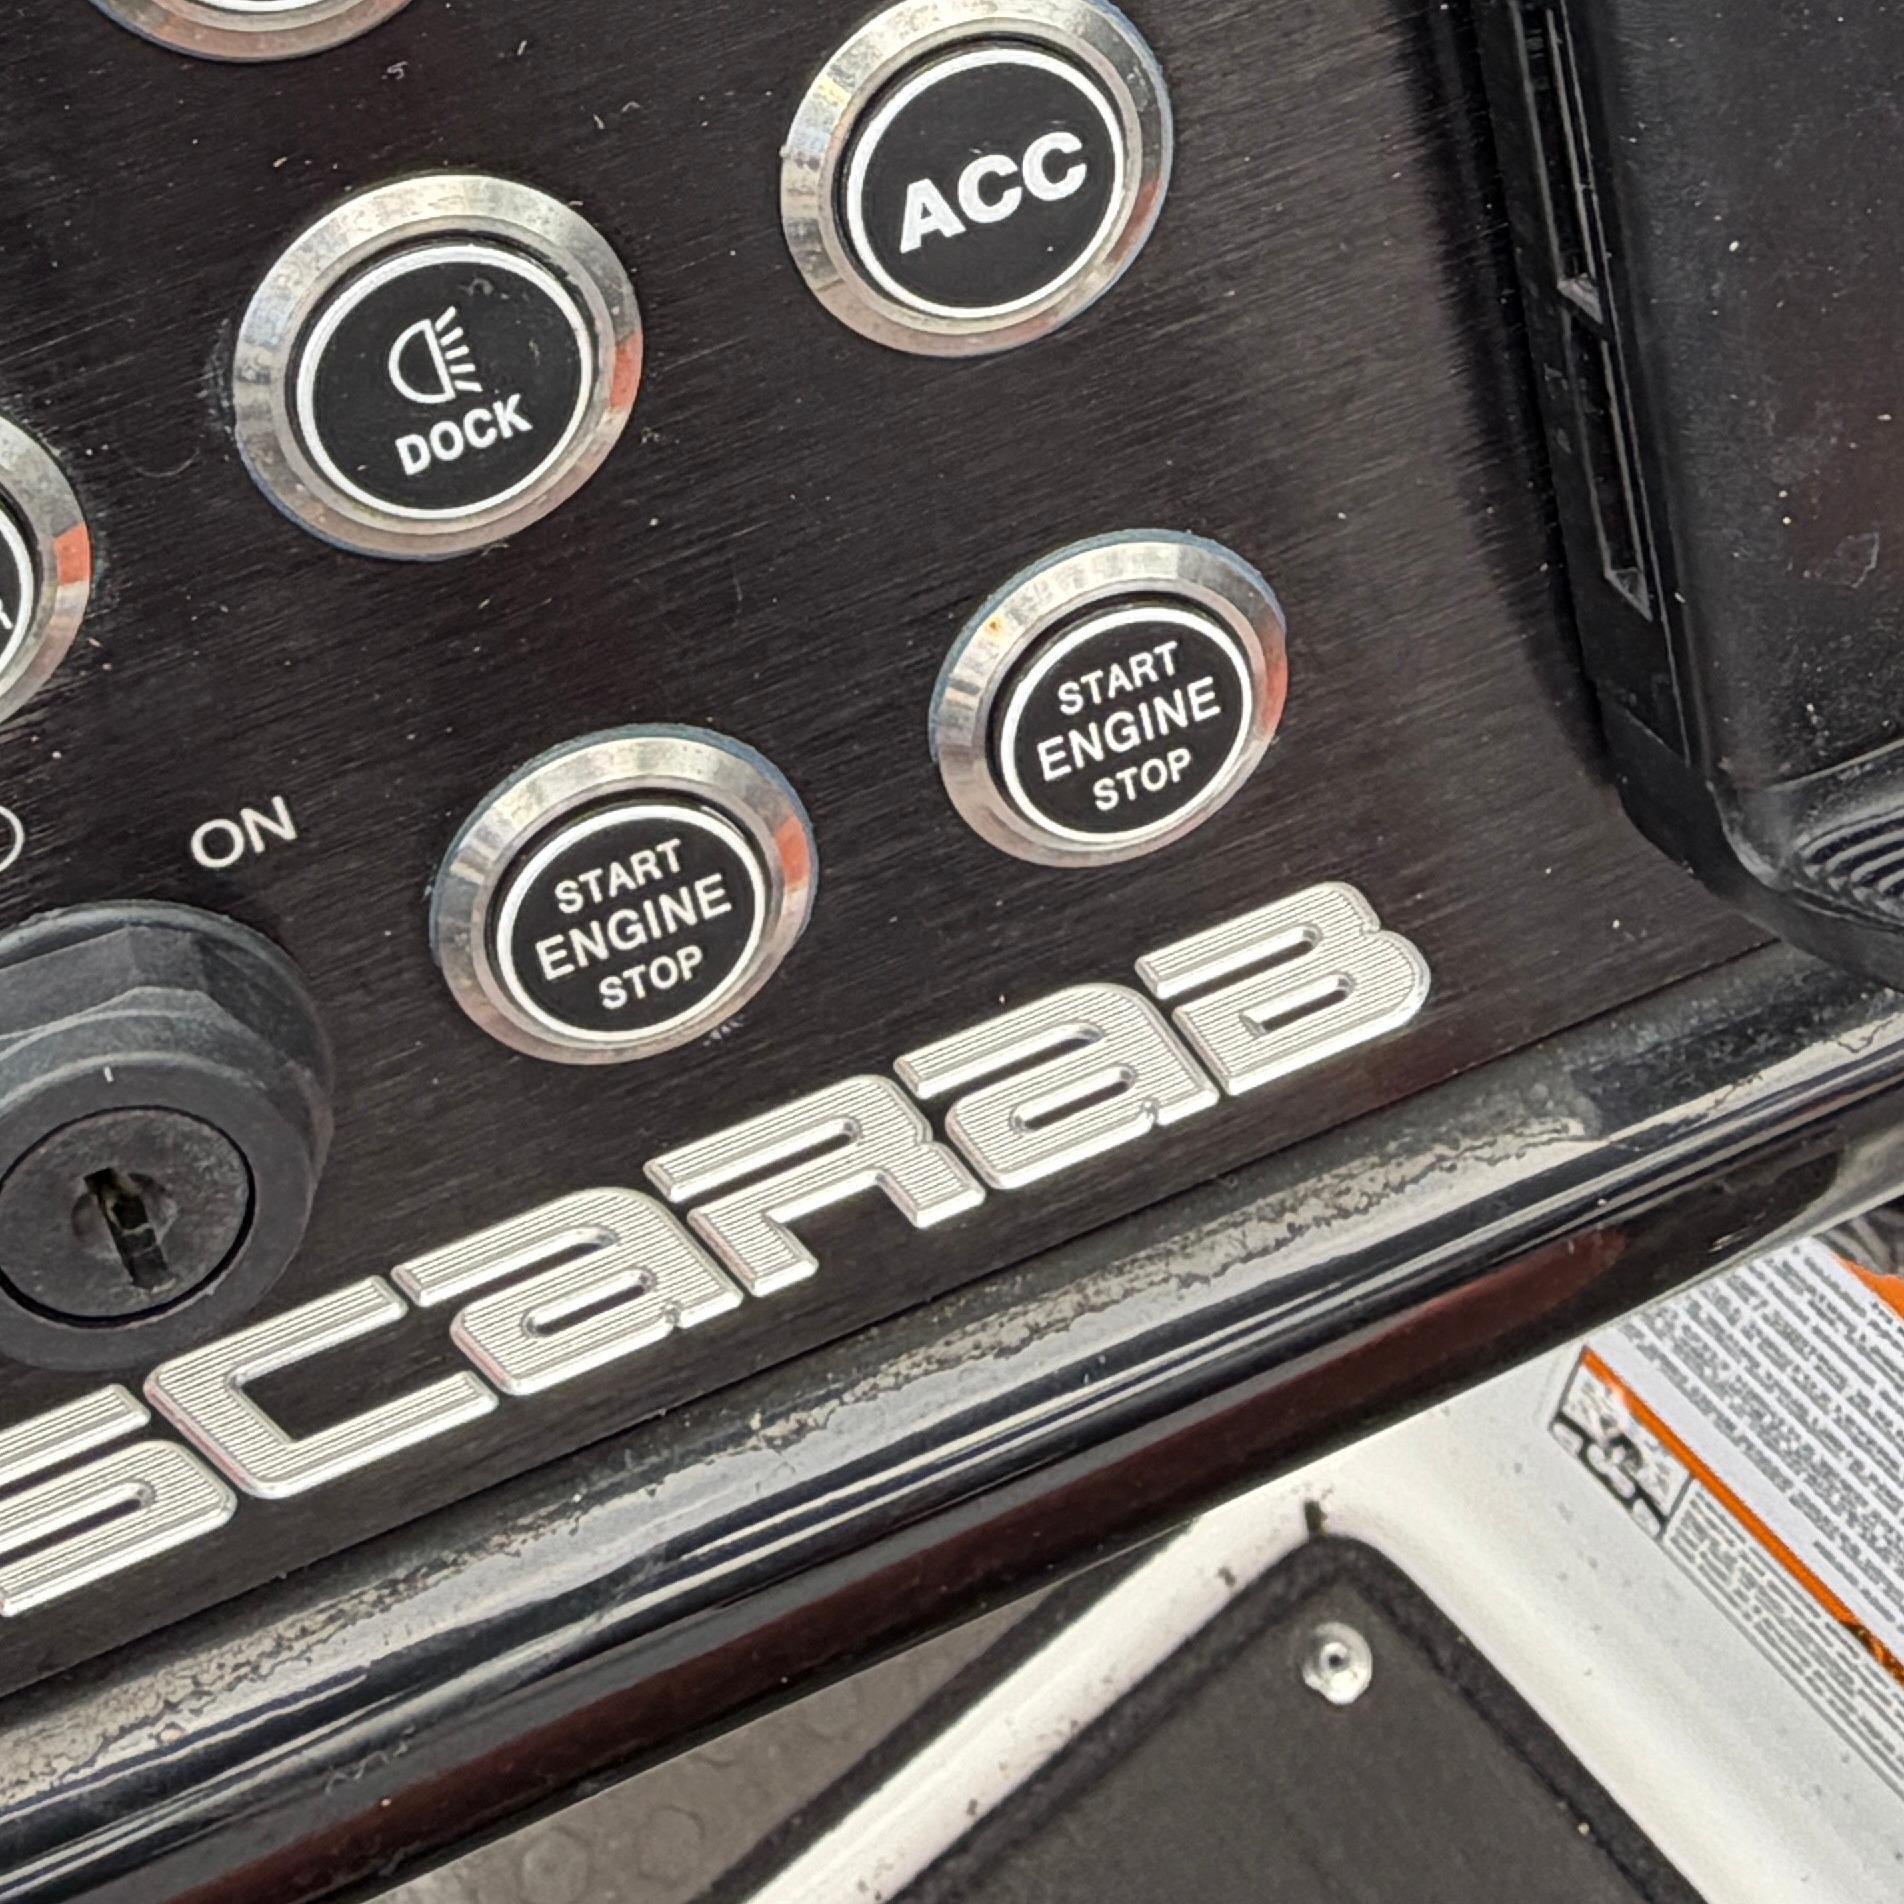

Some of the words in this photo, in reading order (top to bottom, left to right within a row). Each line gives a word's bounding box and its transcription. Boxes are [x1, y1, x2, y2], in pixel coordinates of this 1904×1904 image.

[901, 132, 1087, 253] ACC
[395, 394, 532, 475] DOCK
[1058, 641, 1175, 715] START
[1037, 677, 1220, 781] ENGINE
[1093, 749, 1191, 810] STOP
[191, 796, 296, 867] ON
[555, 839, 679, 913] START
[536, 873, 731, 980] ENGINE
[599, 946, 702, 1009] STOP
